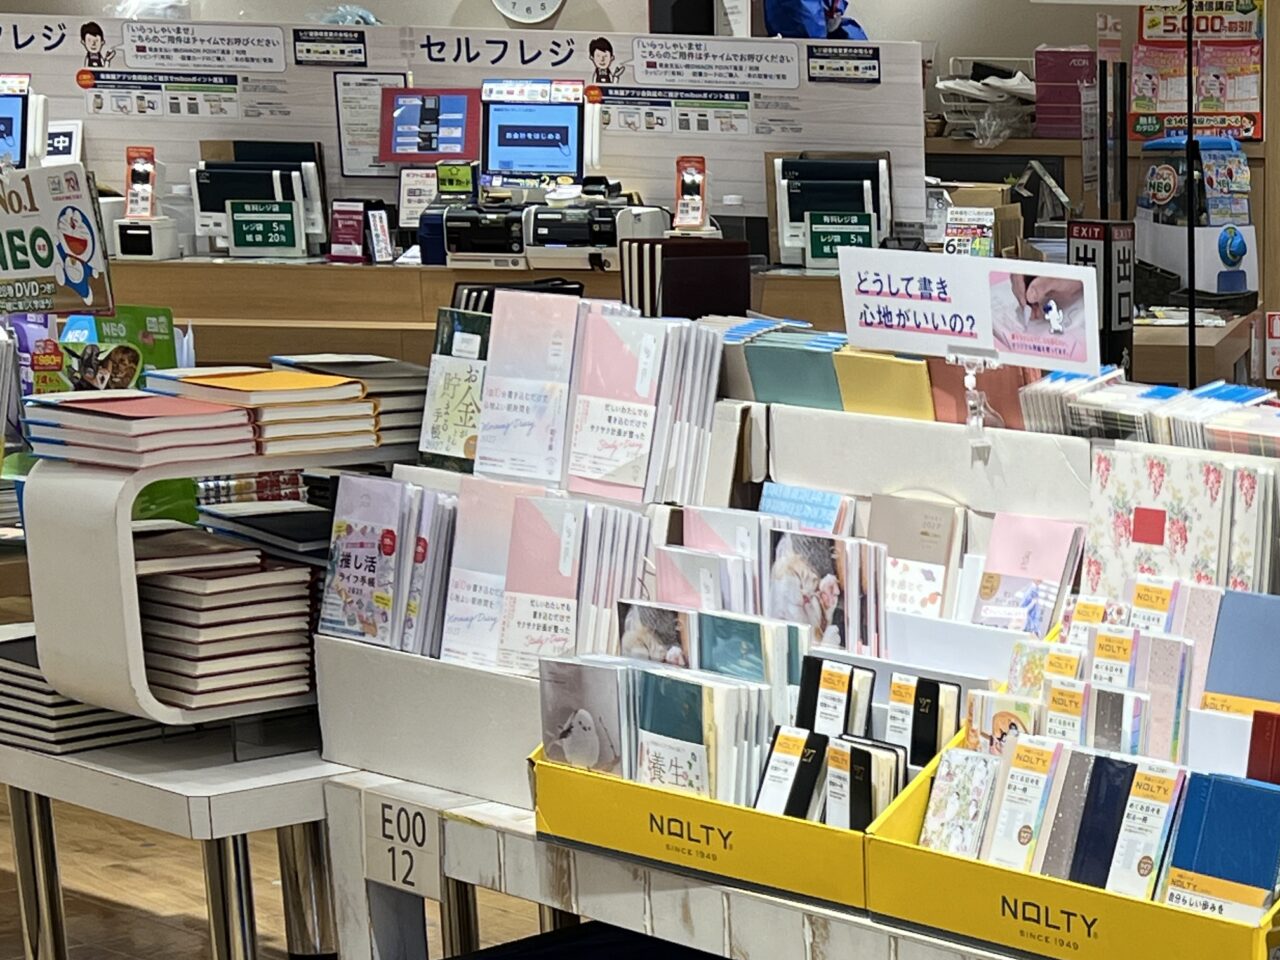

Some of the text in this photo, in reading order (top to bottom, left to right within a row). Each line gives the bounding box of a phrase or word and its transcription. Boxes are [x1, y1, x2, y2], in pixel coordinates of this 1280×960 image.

[0, 24, 67, 52] レジ
[419, 34, 575, 67] セルフレジ
[1073, 226, 1100, 239] EXIT
[1114, 228, 1133, 241] EXIT
[857, 271, 949, 302] どうして書き
[1117, 246, 1132, 326] 出口
[859, 303, 976, 334] 心地がいいの?
[66, 329, 89, 342] NEO
[102, 321, 127, 337] NEO
[339, 552, 377, 574] 推し活
[338, 571, 377, 589] ライフ手帳
[1136, 592, 1167, 605] NOLTY
[1077, 608, 1100, 618] NOLTY
[1098, 642, 1129, 655] NOLTY
[1048, 660, 1074, 671] NOLTY
[822, 676, 847, 688] NOLTY
[892, 688, 913, 700] NOLTY
[1051, 696, 1081, 709] NOLTY
[1015, 752, 1048, 767] NOLTY
[647, 751, 688, 788] 養生
[1135, 782, 1169, 796] NOLTY
[1128, 802, 1161, 817] めくる日々を
[382, 803, 426, 848] E00
[650, 812, 733, 850] NOLTY
[665, 844, 718, 862] SINCE 1949
[387, 846, 415, 888] 12
[1171, 877, 1198, 890] NOLTY
[1168, 891, 1224, 915] 自分らしい歩みを
[1001, 895, 1098, 938] NOLTY
[1019, 929, 1079, 951] SINCE 1949
